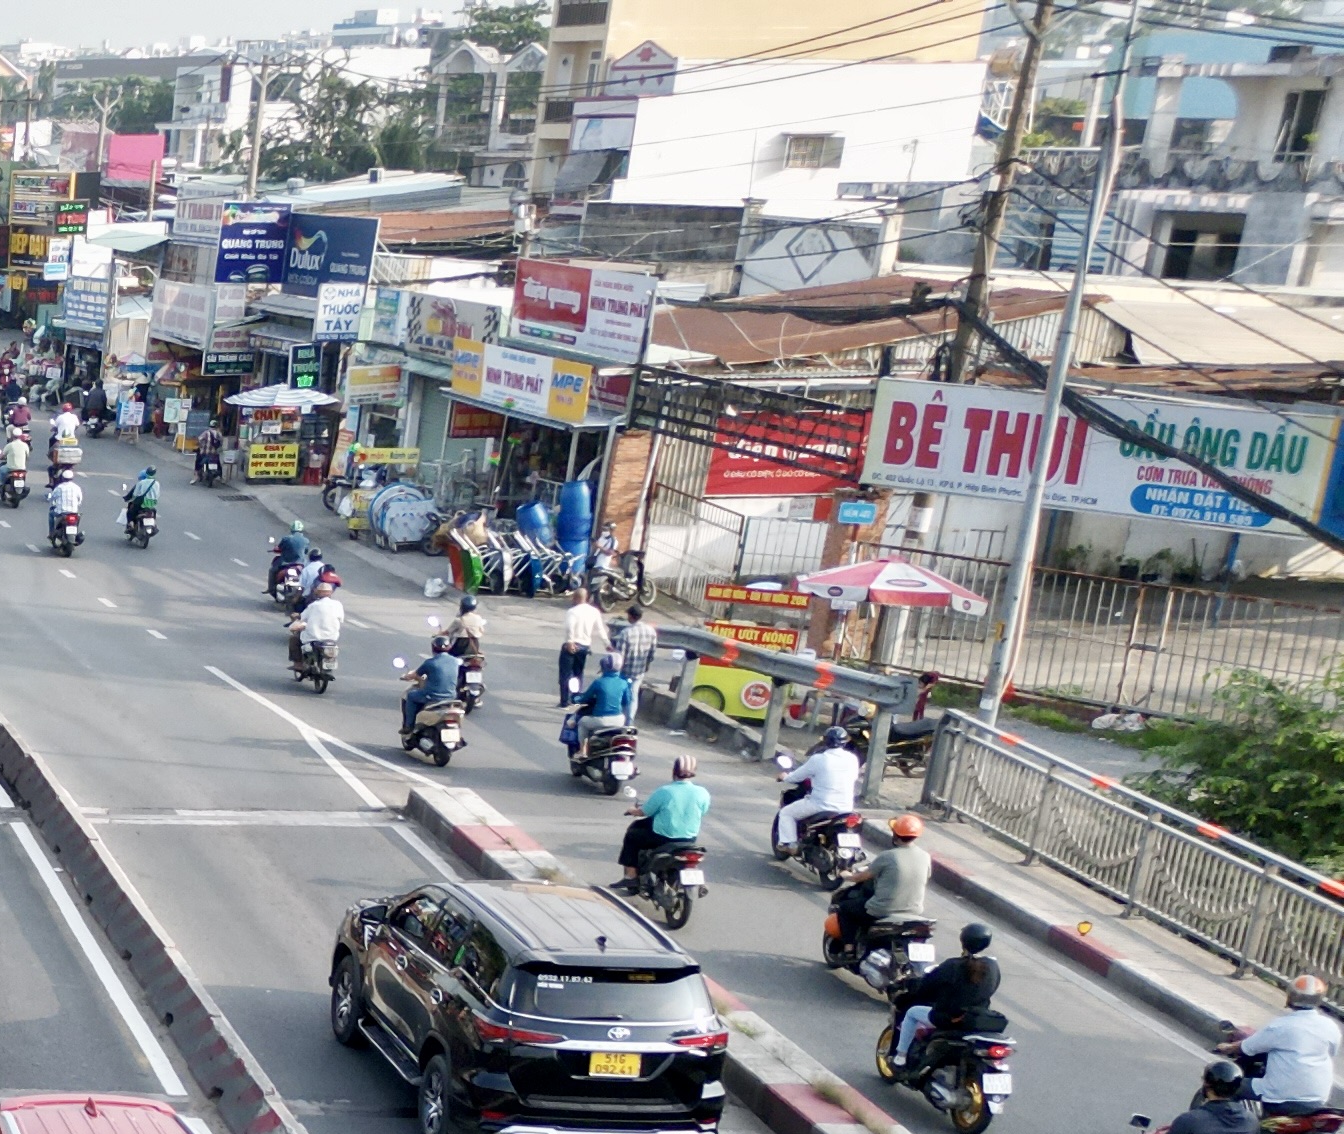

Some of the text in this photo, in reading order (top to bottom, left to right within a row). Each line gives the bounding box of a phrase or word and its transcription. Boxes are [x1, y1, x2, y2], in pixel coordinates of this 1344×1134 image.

[290, 247, 321, 271] Dulux
[322, 301, 360, 316] THUỐC
[551, 373, 585, 394] MPE
[882, 389, 1089, 486] BÊ THUI
[1168, 468, 1197, 486] TRƯA
[1145, 486, 1189, 510] NHẬN
[1193, 491, 1224, 513] ĐẶT
[605, 1054, 626, 1064] 51G
[594, 1064, 633, 1074] 092.41
